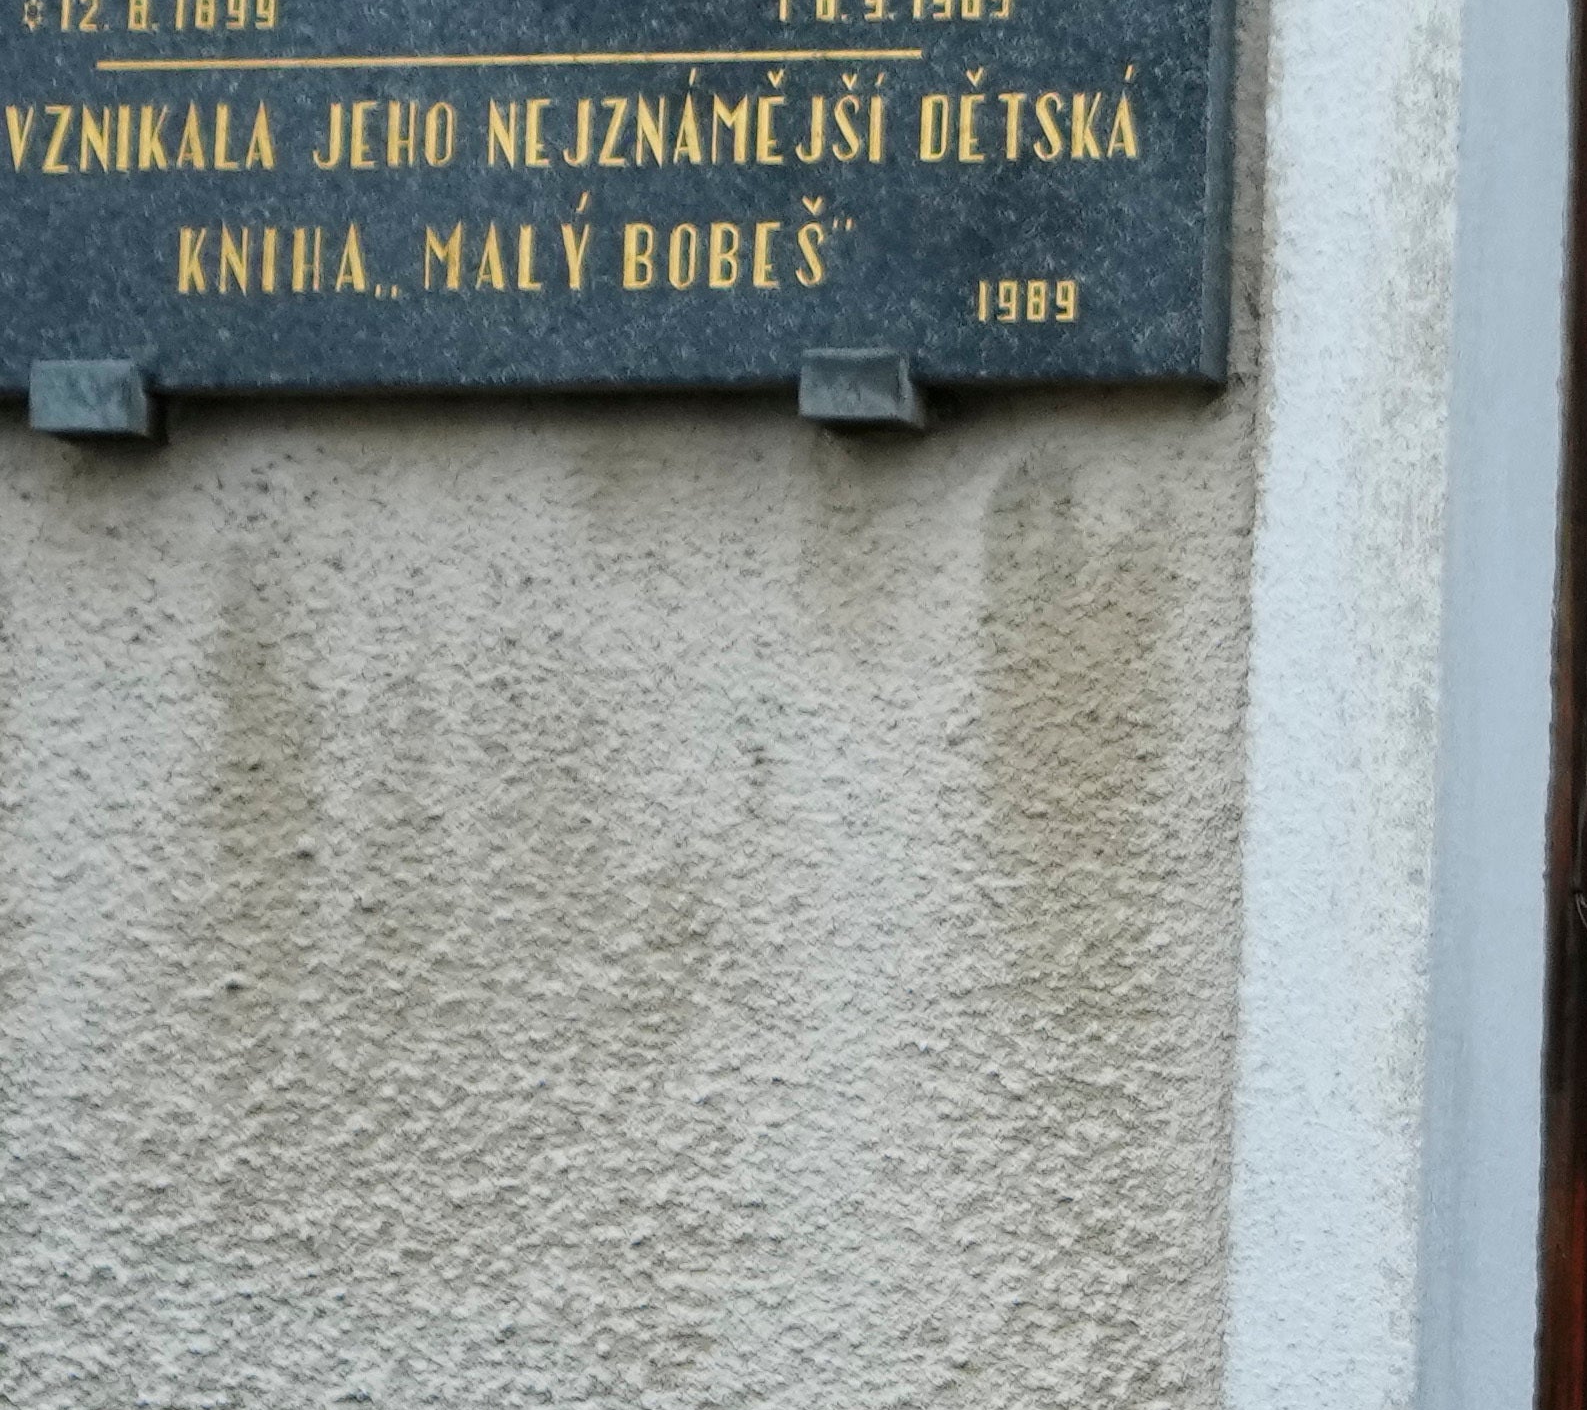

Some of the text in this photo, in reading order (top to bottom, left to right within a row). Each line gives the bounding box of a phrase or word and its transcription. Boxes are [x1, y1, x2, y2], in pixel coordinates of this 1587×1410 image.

[5, 64, 1138, 175] VZNIKALA JEHO NEJZNÁMĚJŠÍ DĚTSKÁ
[977, 279, 1079, 324] 1989
